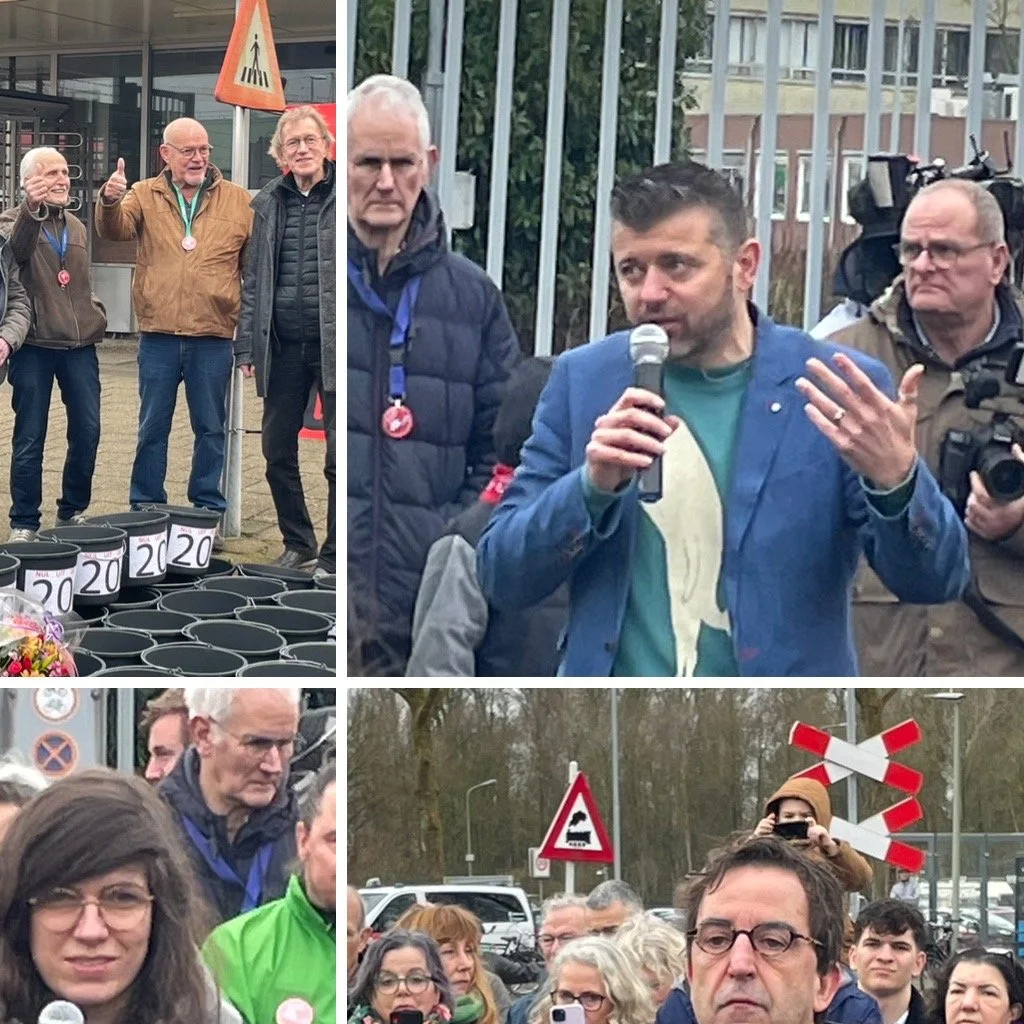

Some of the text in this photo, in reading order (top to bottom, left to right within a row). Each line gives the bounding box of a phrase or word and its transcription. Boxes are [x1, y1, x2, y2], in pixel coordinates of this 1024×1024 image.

[136, 540, 166, 577] 20
[171, 534, 212, 567] 20
[80, 558, 120, 594] 20
[32, 577, 73, 613] 20
